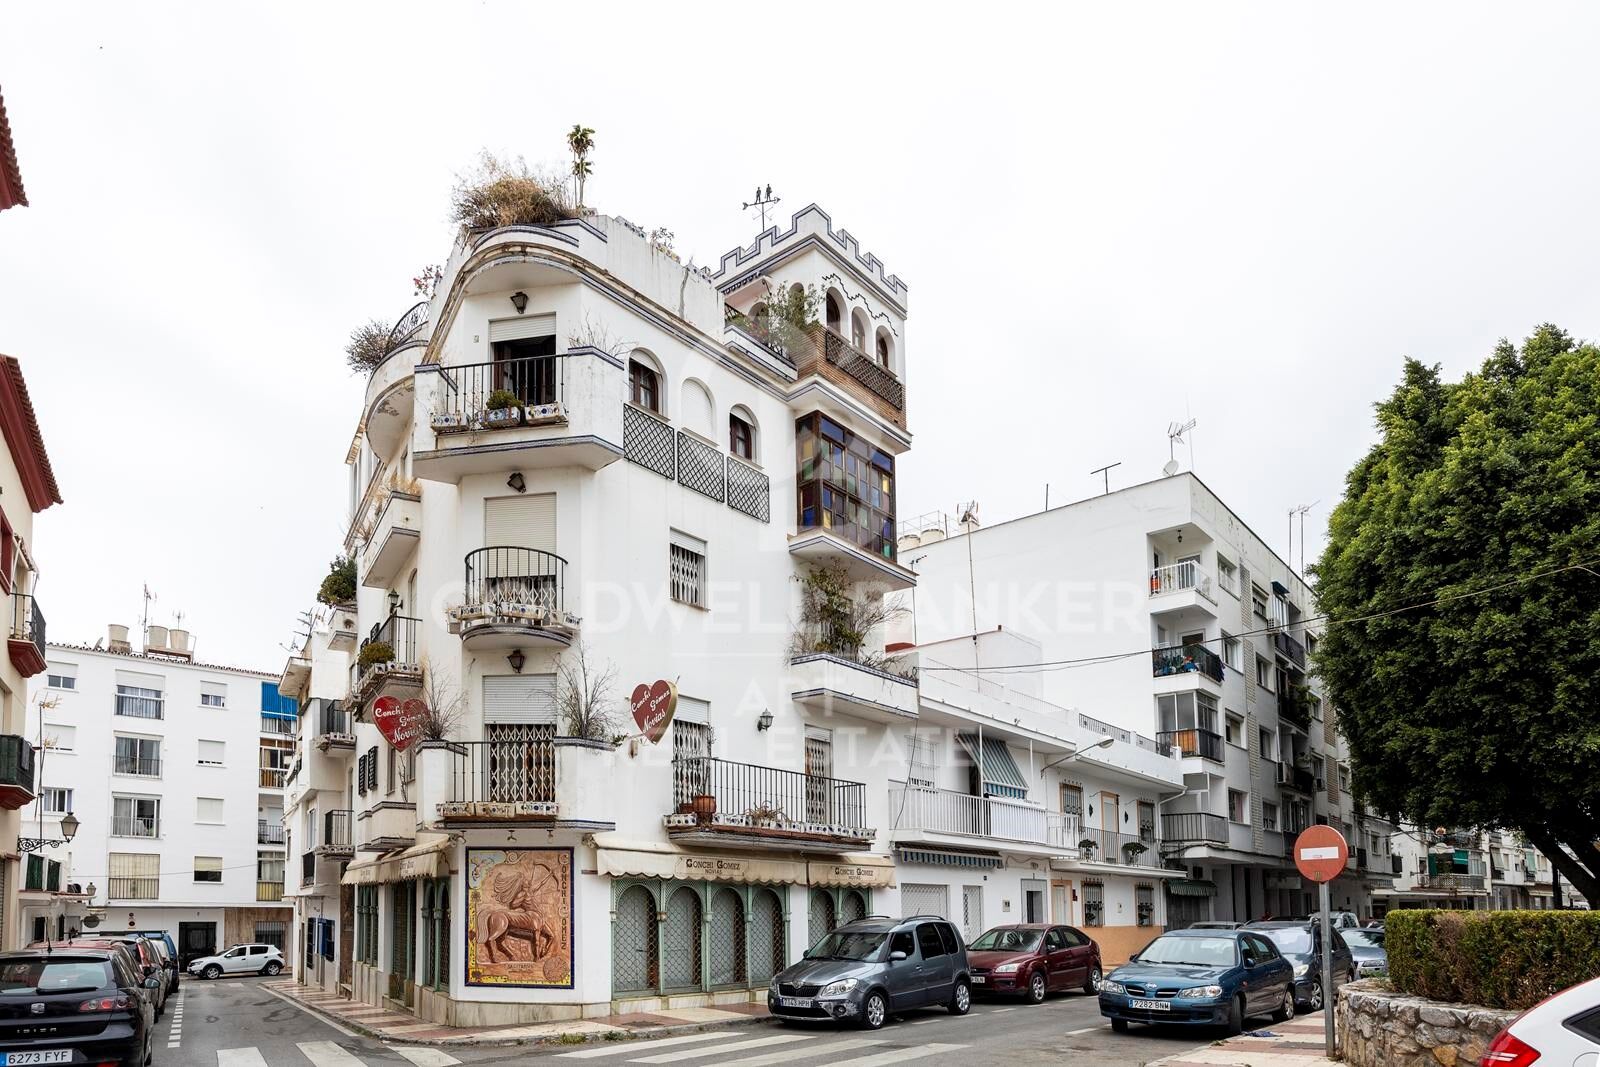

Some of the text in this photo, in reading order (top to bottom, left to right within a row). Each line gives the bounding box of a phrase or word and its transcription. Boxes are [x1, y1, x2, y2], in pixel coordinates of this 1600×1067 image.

[631, 690, 651, 712] Conchi
[643, 709, 666, 734] Novias
[392, 726, 423, 743] Novia
[686, 859, 741, 871] CONCHI GOMEZ
[8, 1050, 69, 1064] 6273 FYF
